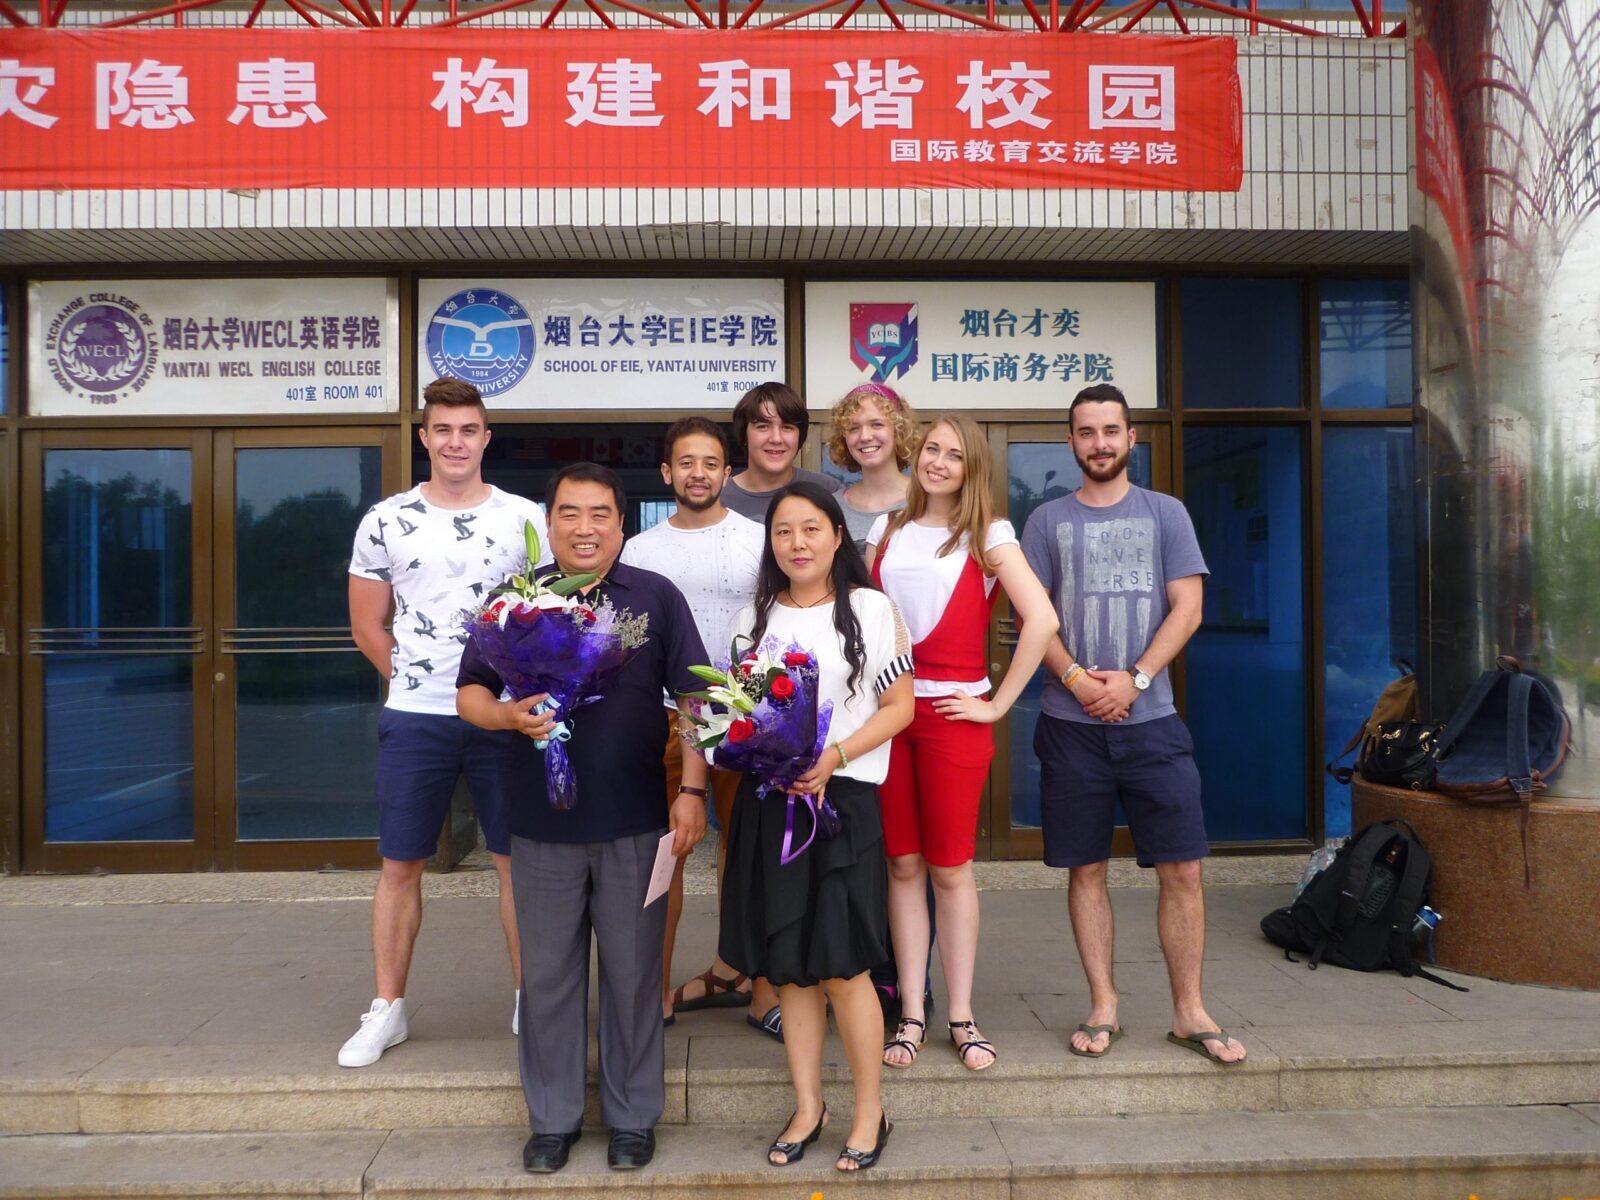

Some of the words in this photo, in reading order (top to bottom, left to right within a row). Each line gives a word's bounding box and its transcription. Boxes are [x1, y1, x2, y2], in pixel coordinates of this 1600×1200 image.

[430, 57, 1176, 131] 构建和谐校园
[889, 138, 1178, 166] 国际教育交流学院
[45, 296, 86, 350] EXCHANGE
[89, 292, 140, 313] COLLEGE
[139, 312, 154, 327] OF
[163, 316, 381, 351] 烟台大学WECL英语学院
[543, 314, 778, 347] 烟台大学EIE学院
[959, 308, 1080, 338] 烟台才奕
[76, 344, 126, 357] WECL
[162, 362, 210, 378] YANTAI
[218, 362, 254, 377] WECL
[262, 361, 316, 377] ENGLISH
[324, 360, 381, 376] COLLEGE
[543, 360, 598, 373] SCHOOL
[600, 360, 618, 373] OF
[620, 360, 644, 374] EIE,
[647, 360, 696, 373] YANTAI
[698, 360, 777, 373] UNIVERSITY
[931, 352, 1114, 383] 国际商务学院
[286, 385, 317, 401] 401室
[323, 386, 359, 400] ROOM
[364, 385, 383, 398] 401
[706, 380, 729, 392] 401室
